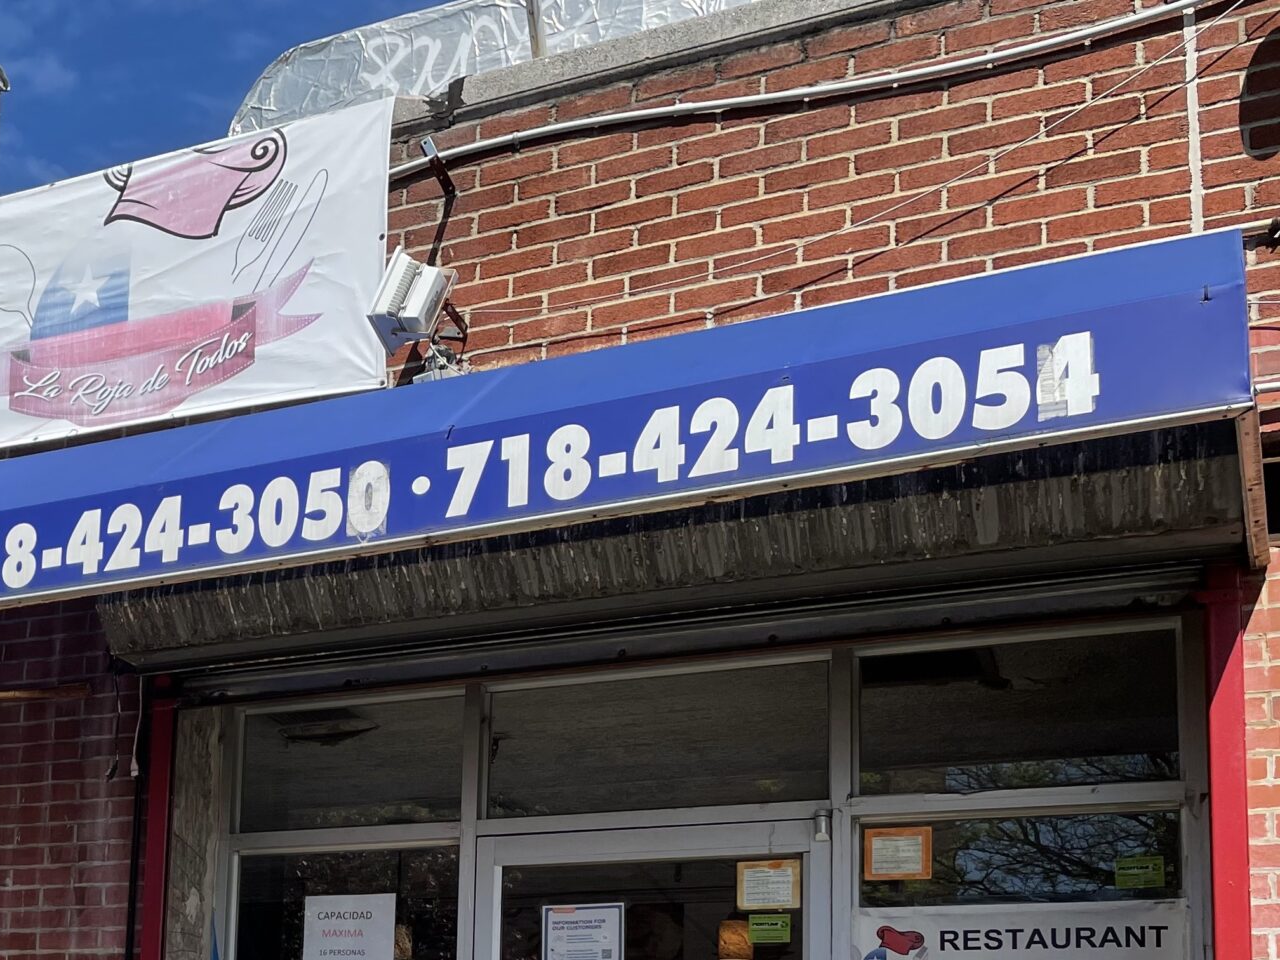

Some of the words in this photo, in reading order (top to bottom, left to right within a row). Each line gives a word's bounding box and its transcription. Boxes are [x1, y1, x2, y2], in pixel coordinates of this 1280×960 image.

[14, 368, 62, 401] La
[69, 373, 134, 416] Roja
[140, 364, 170, 396] de
[175, 330, 254, 386] Todos
[445, 330, 1100, 519] 718-424-3054
[317, 911, 373, 920] CAPACIDAD
[321, 929, 364, 938] MAXIMA
[939, 925, 1169, 951] RESTAURANT
